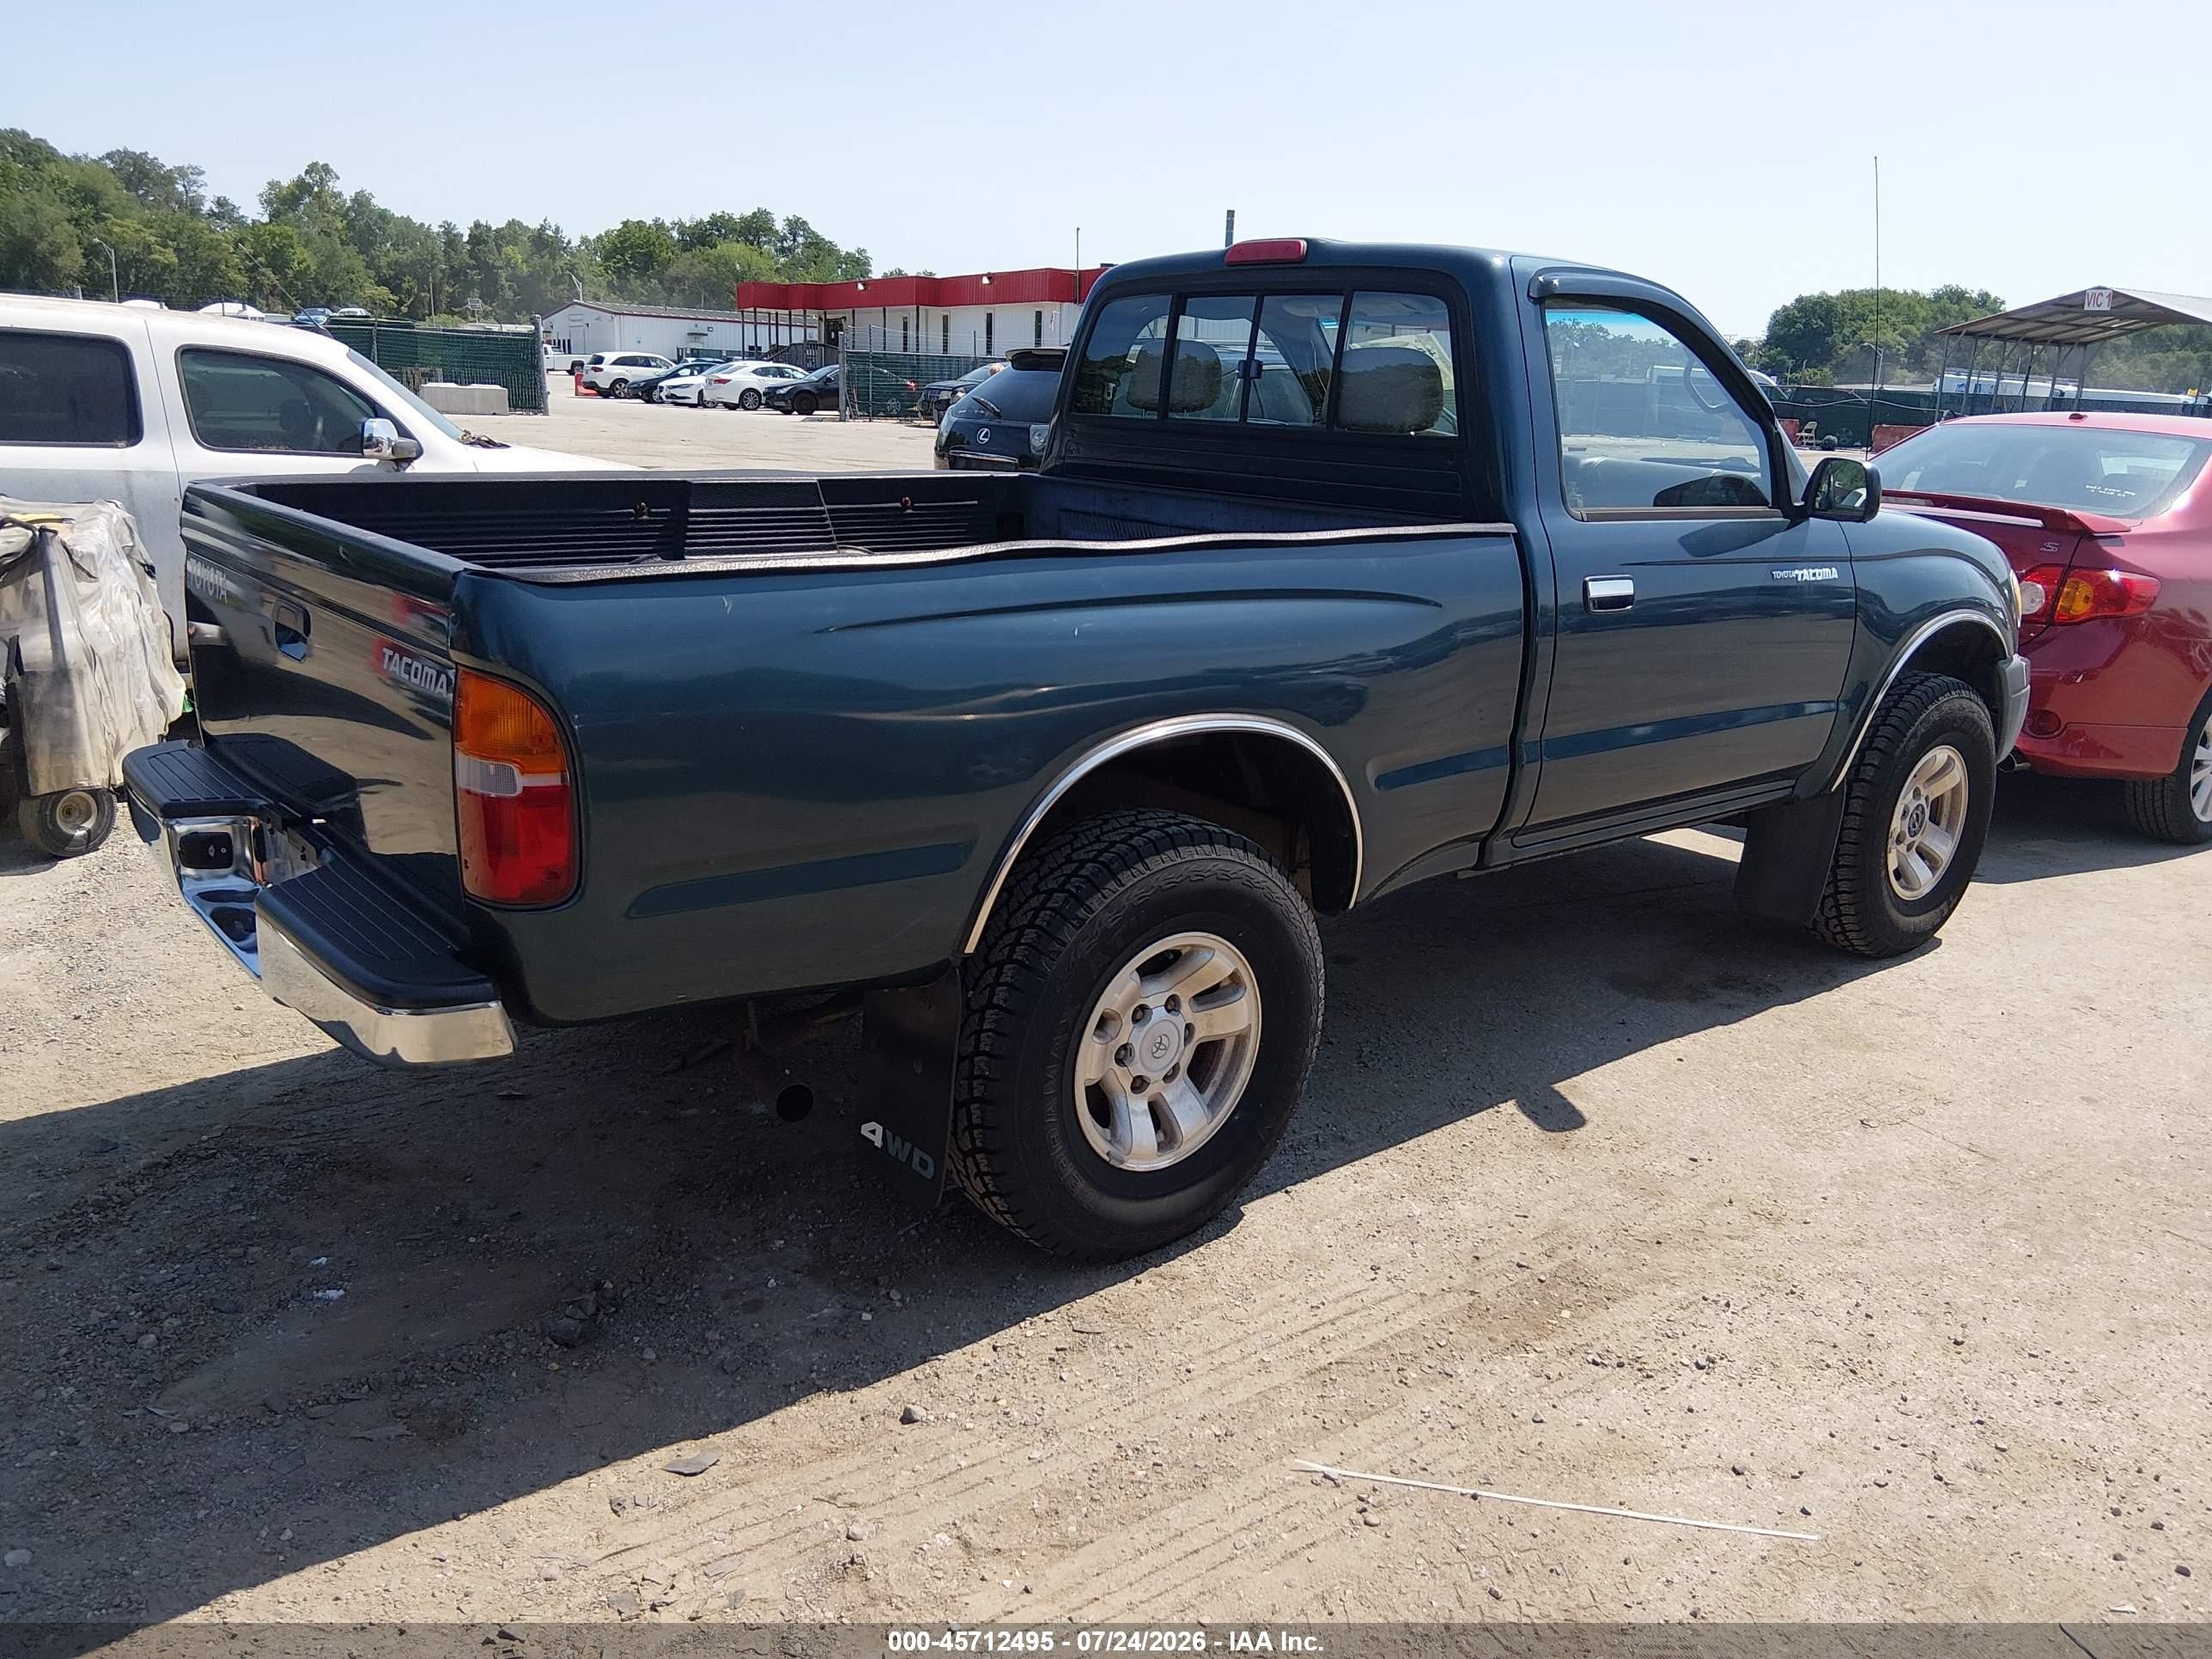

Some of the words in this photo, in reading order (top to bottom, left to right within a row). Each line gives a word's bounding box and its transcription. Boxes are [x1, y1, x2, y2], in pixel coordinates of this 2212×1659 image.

[2087, 292, 2103, 307] VIC
[2106, 292, 2112, 307] 1
[2039, 541, 2060, 552] S
[187, 557, 228, 604] TOYOTA
[1771, 569, 1796, 580] TOYOTA
[1796, 567, 1838, 581] TACOMA
[381, 647, 448, 696] TACOMA
[860, 1121, 935, 1180] 4WD
